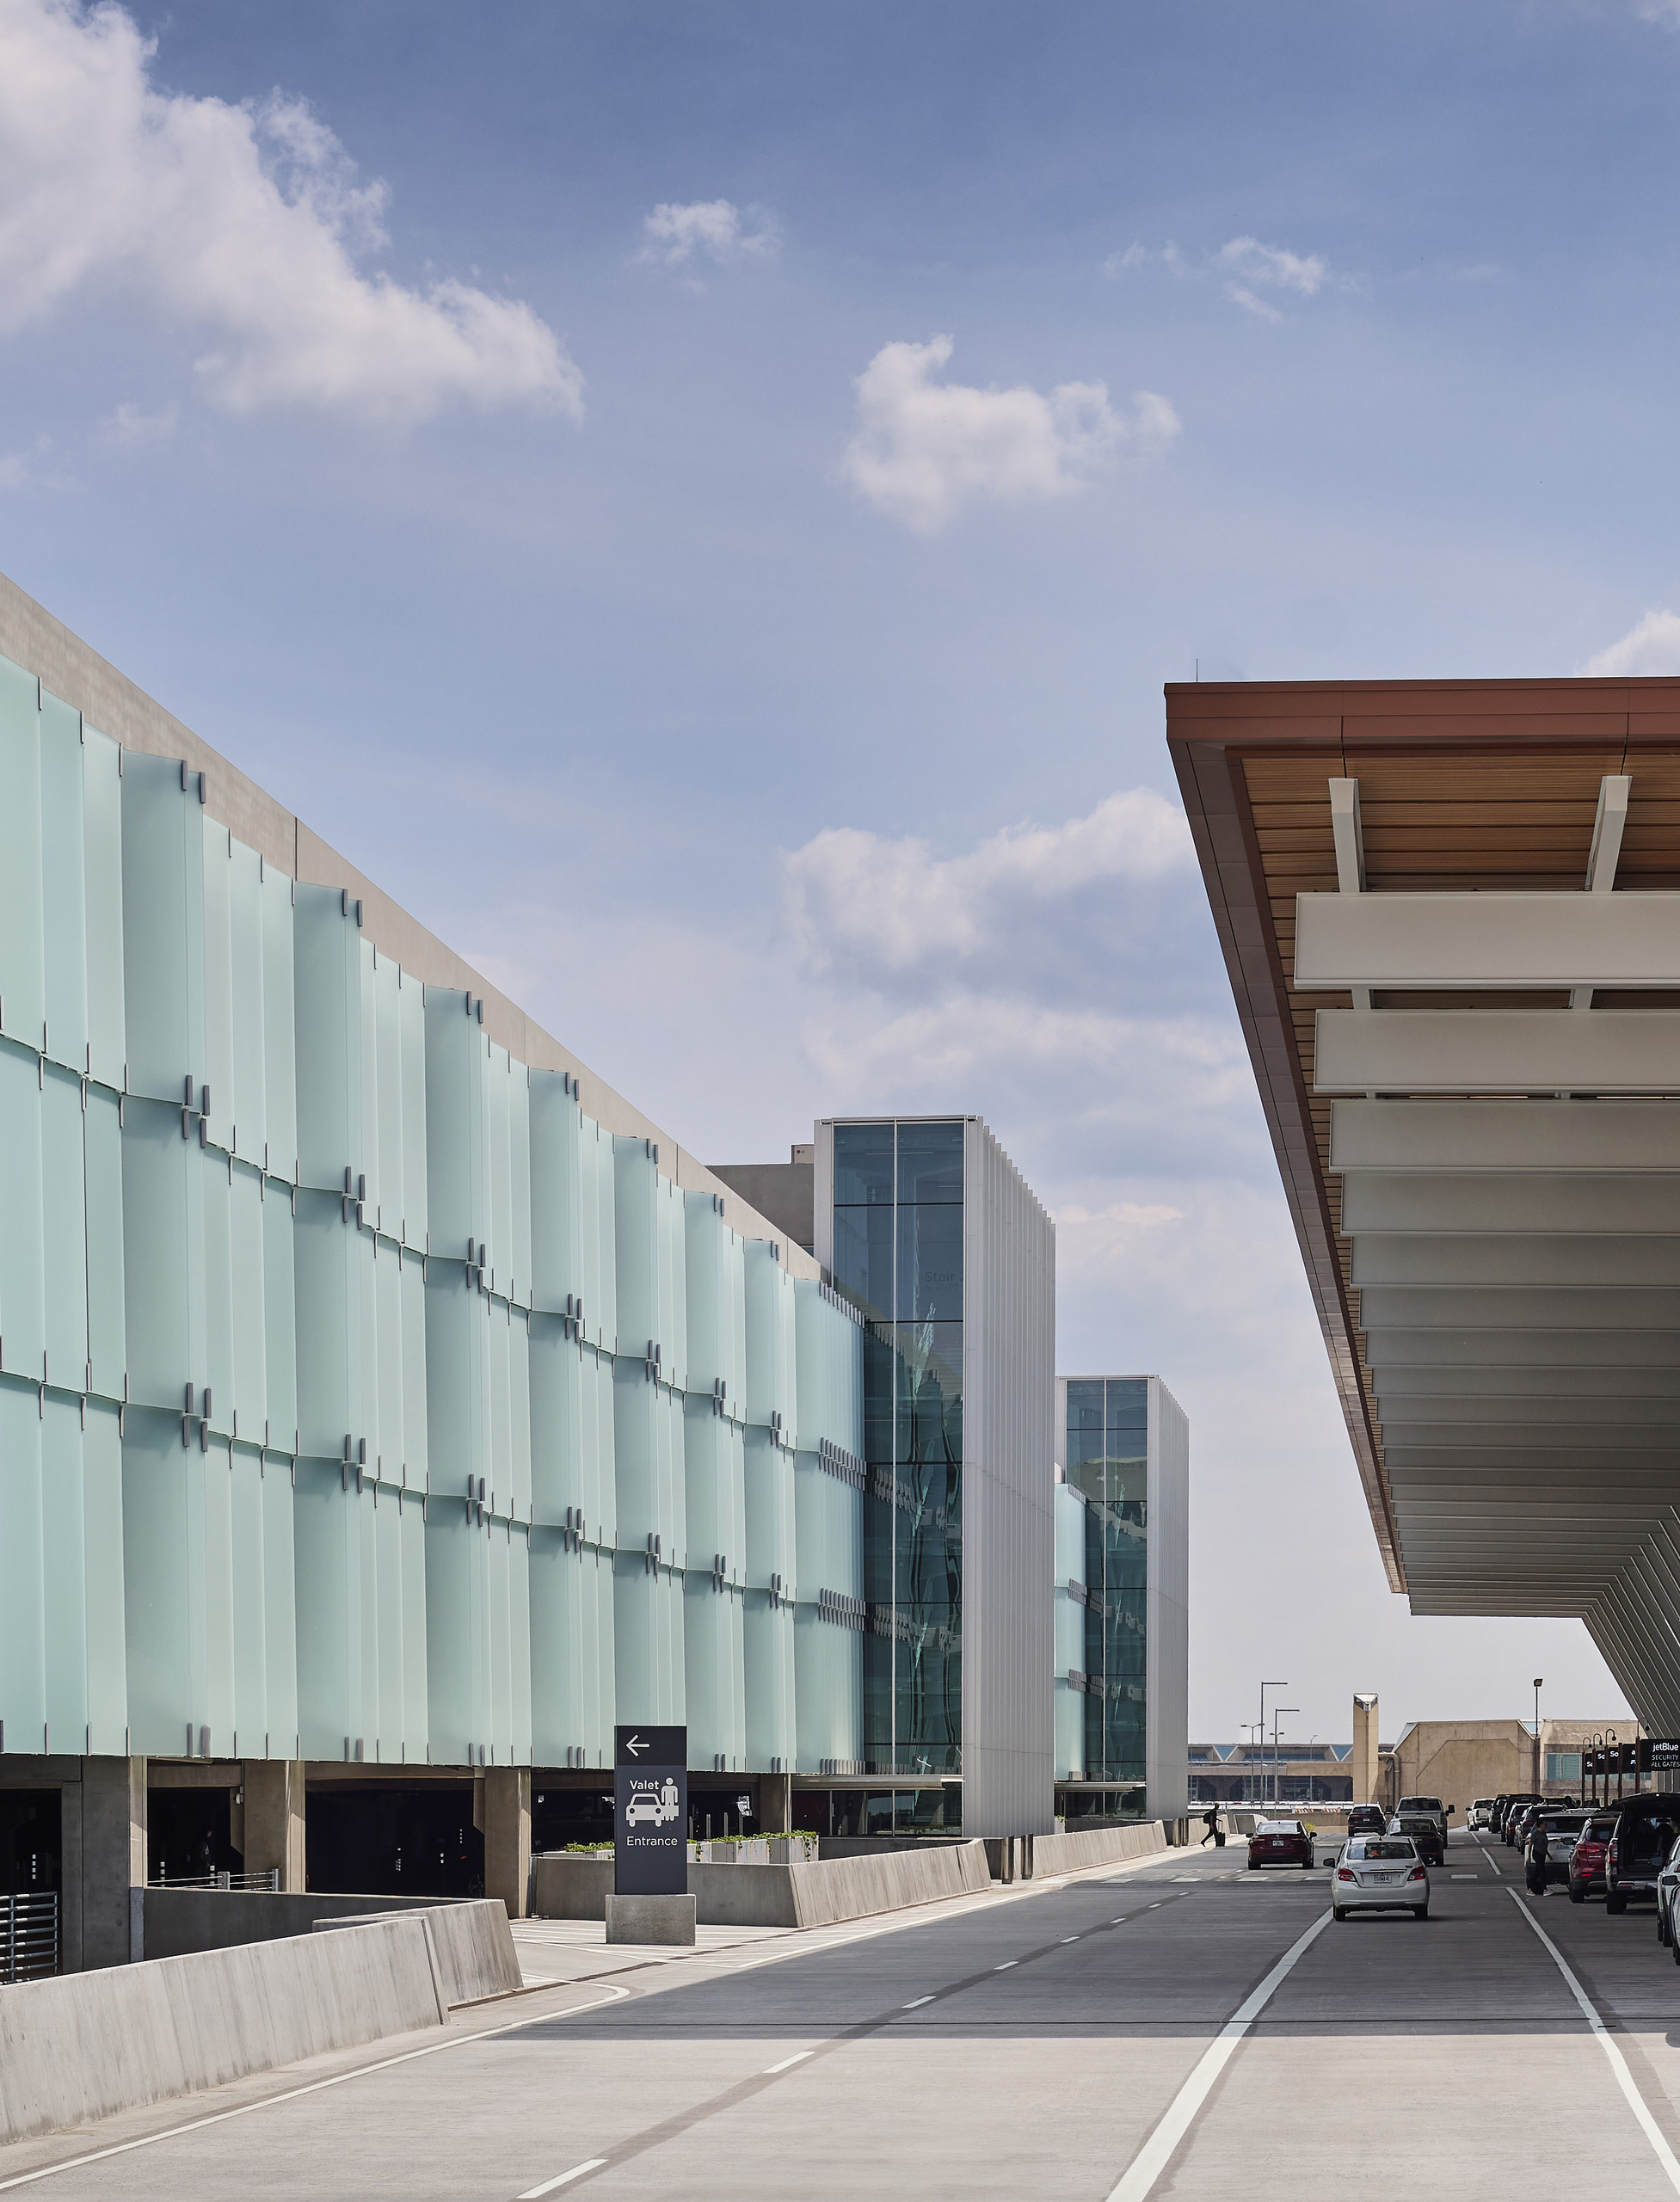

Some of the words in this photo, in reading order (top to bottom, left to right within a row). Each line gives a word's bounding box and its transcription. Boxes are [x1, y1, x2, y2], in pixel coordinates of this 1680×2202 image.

[925, 1270, 955, 1282] Stair
[1652, 1743, 1679, 1752] jetBlue
[629, 1780, 660, 1790] Valet
[626, 1836, 678, 1846] Entrance
